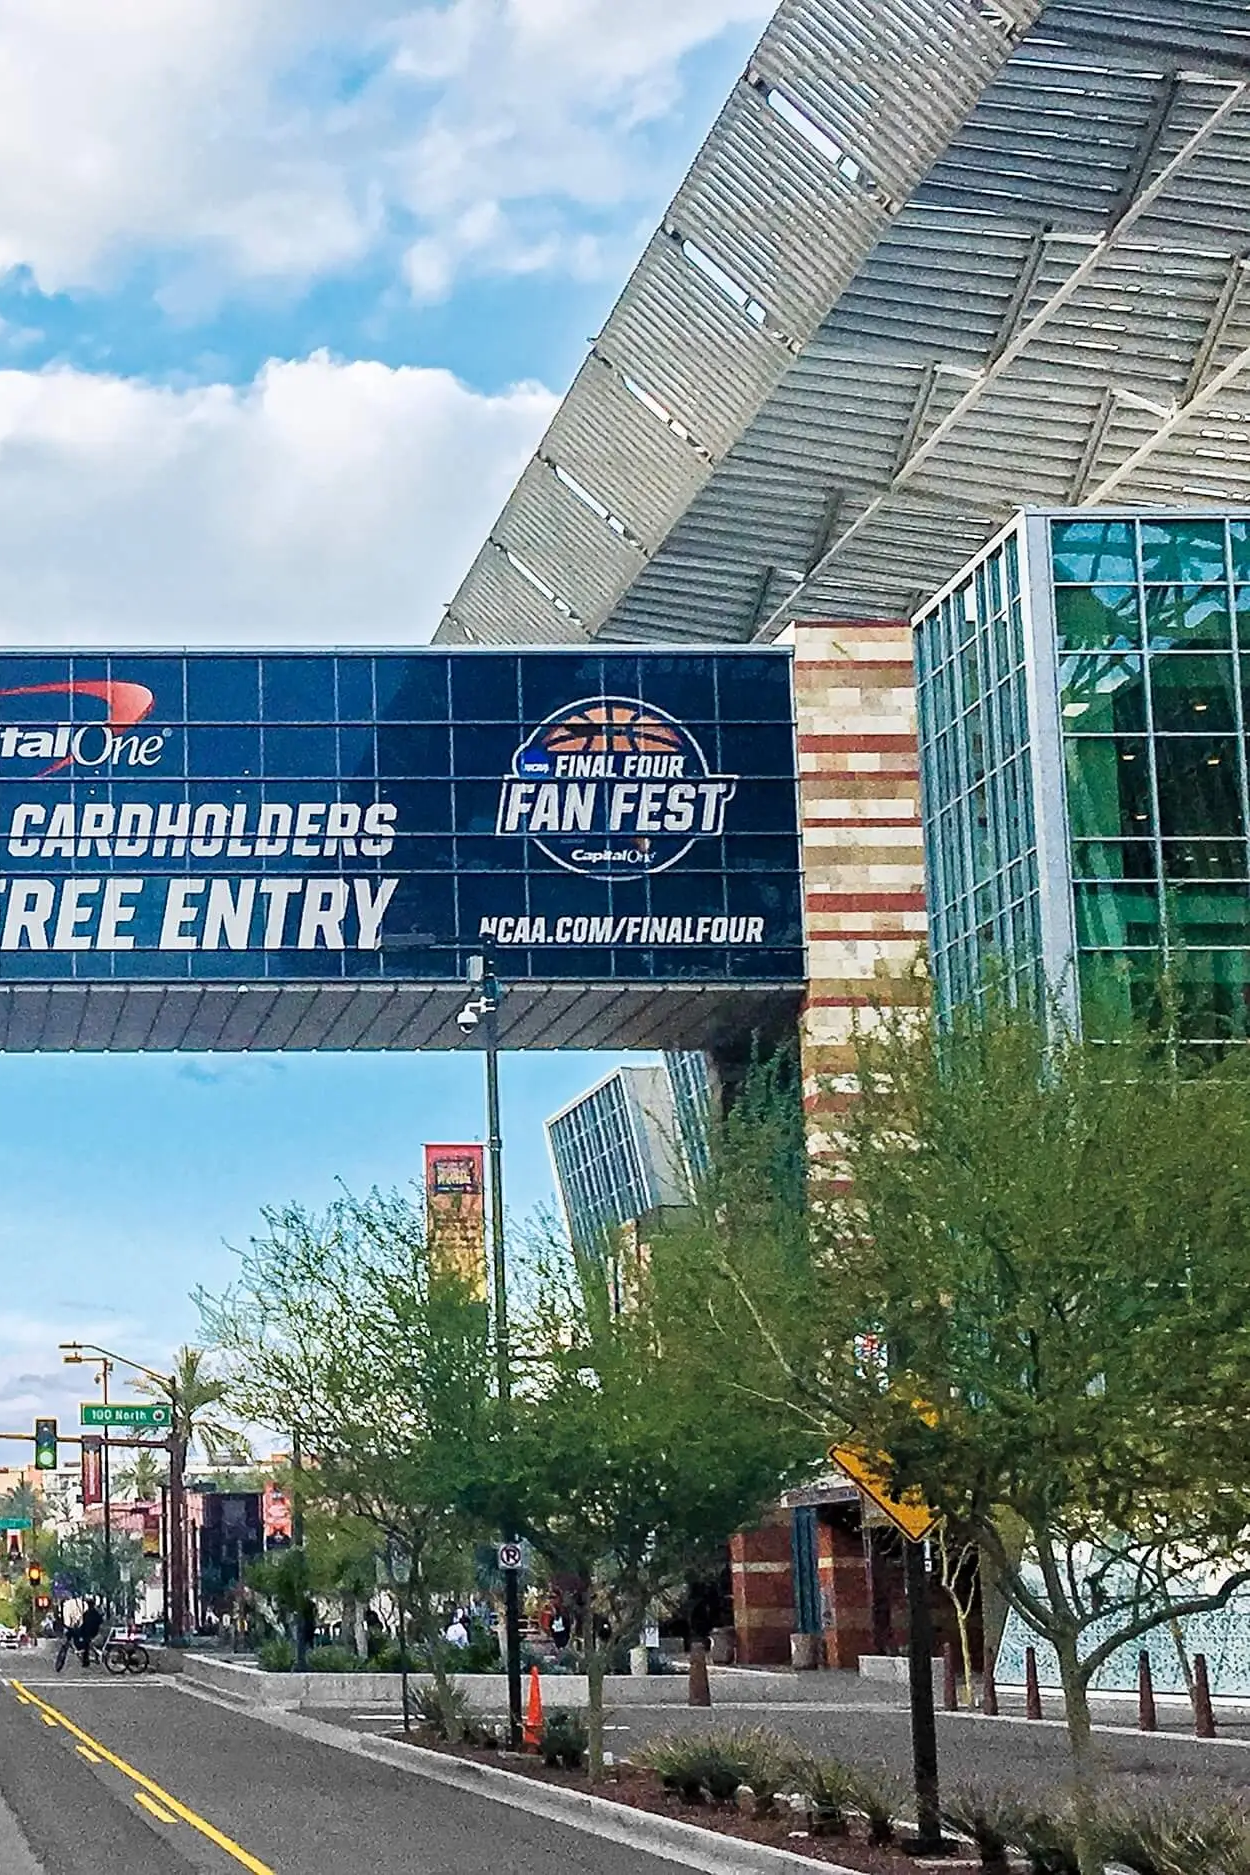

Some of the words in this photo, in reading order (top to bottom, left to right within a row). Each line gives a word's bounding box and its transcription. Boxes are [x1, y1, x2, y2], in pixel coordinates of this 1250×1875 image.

[555, 755, 617, 778] FINAL
[623, 755, 686, 778] FOUR
[7, 803, 398, 858] CARDHOLDERS
[505, 782, 597, 832] FAN
[609, 782, 727, 832] FEST
[158, 878, 399, 951] ENTRY
[91, 1409, 112, 1421] 100
[115, 1409, 147, 1421] North
